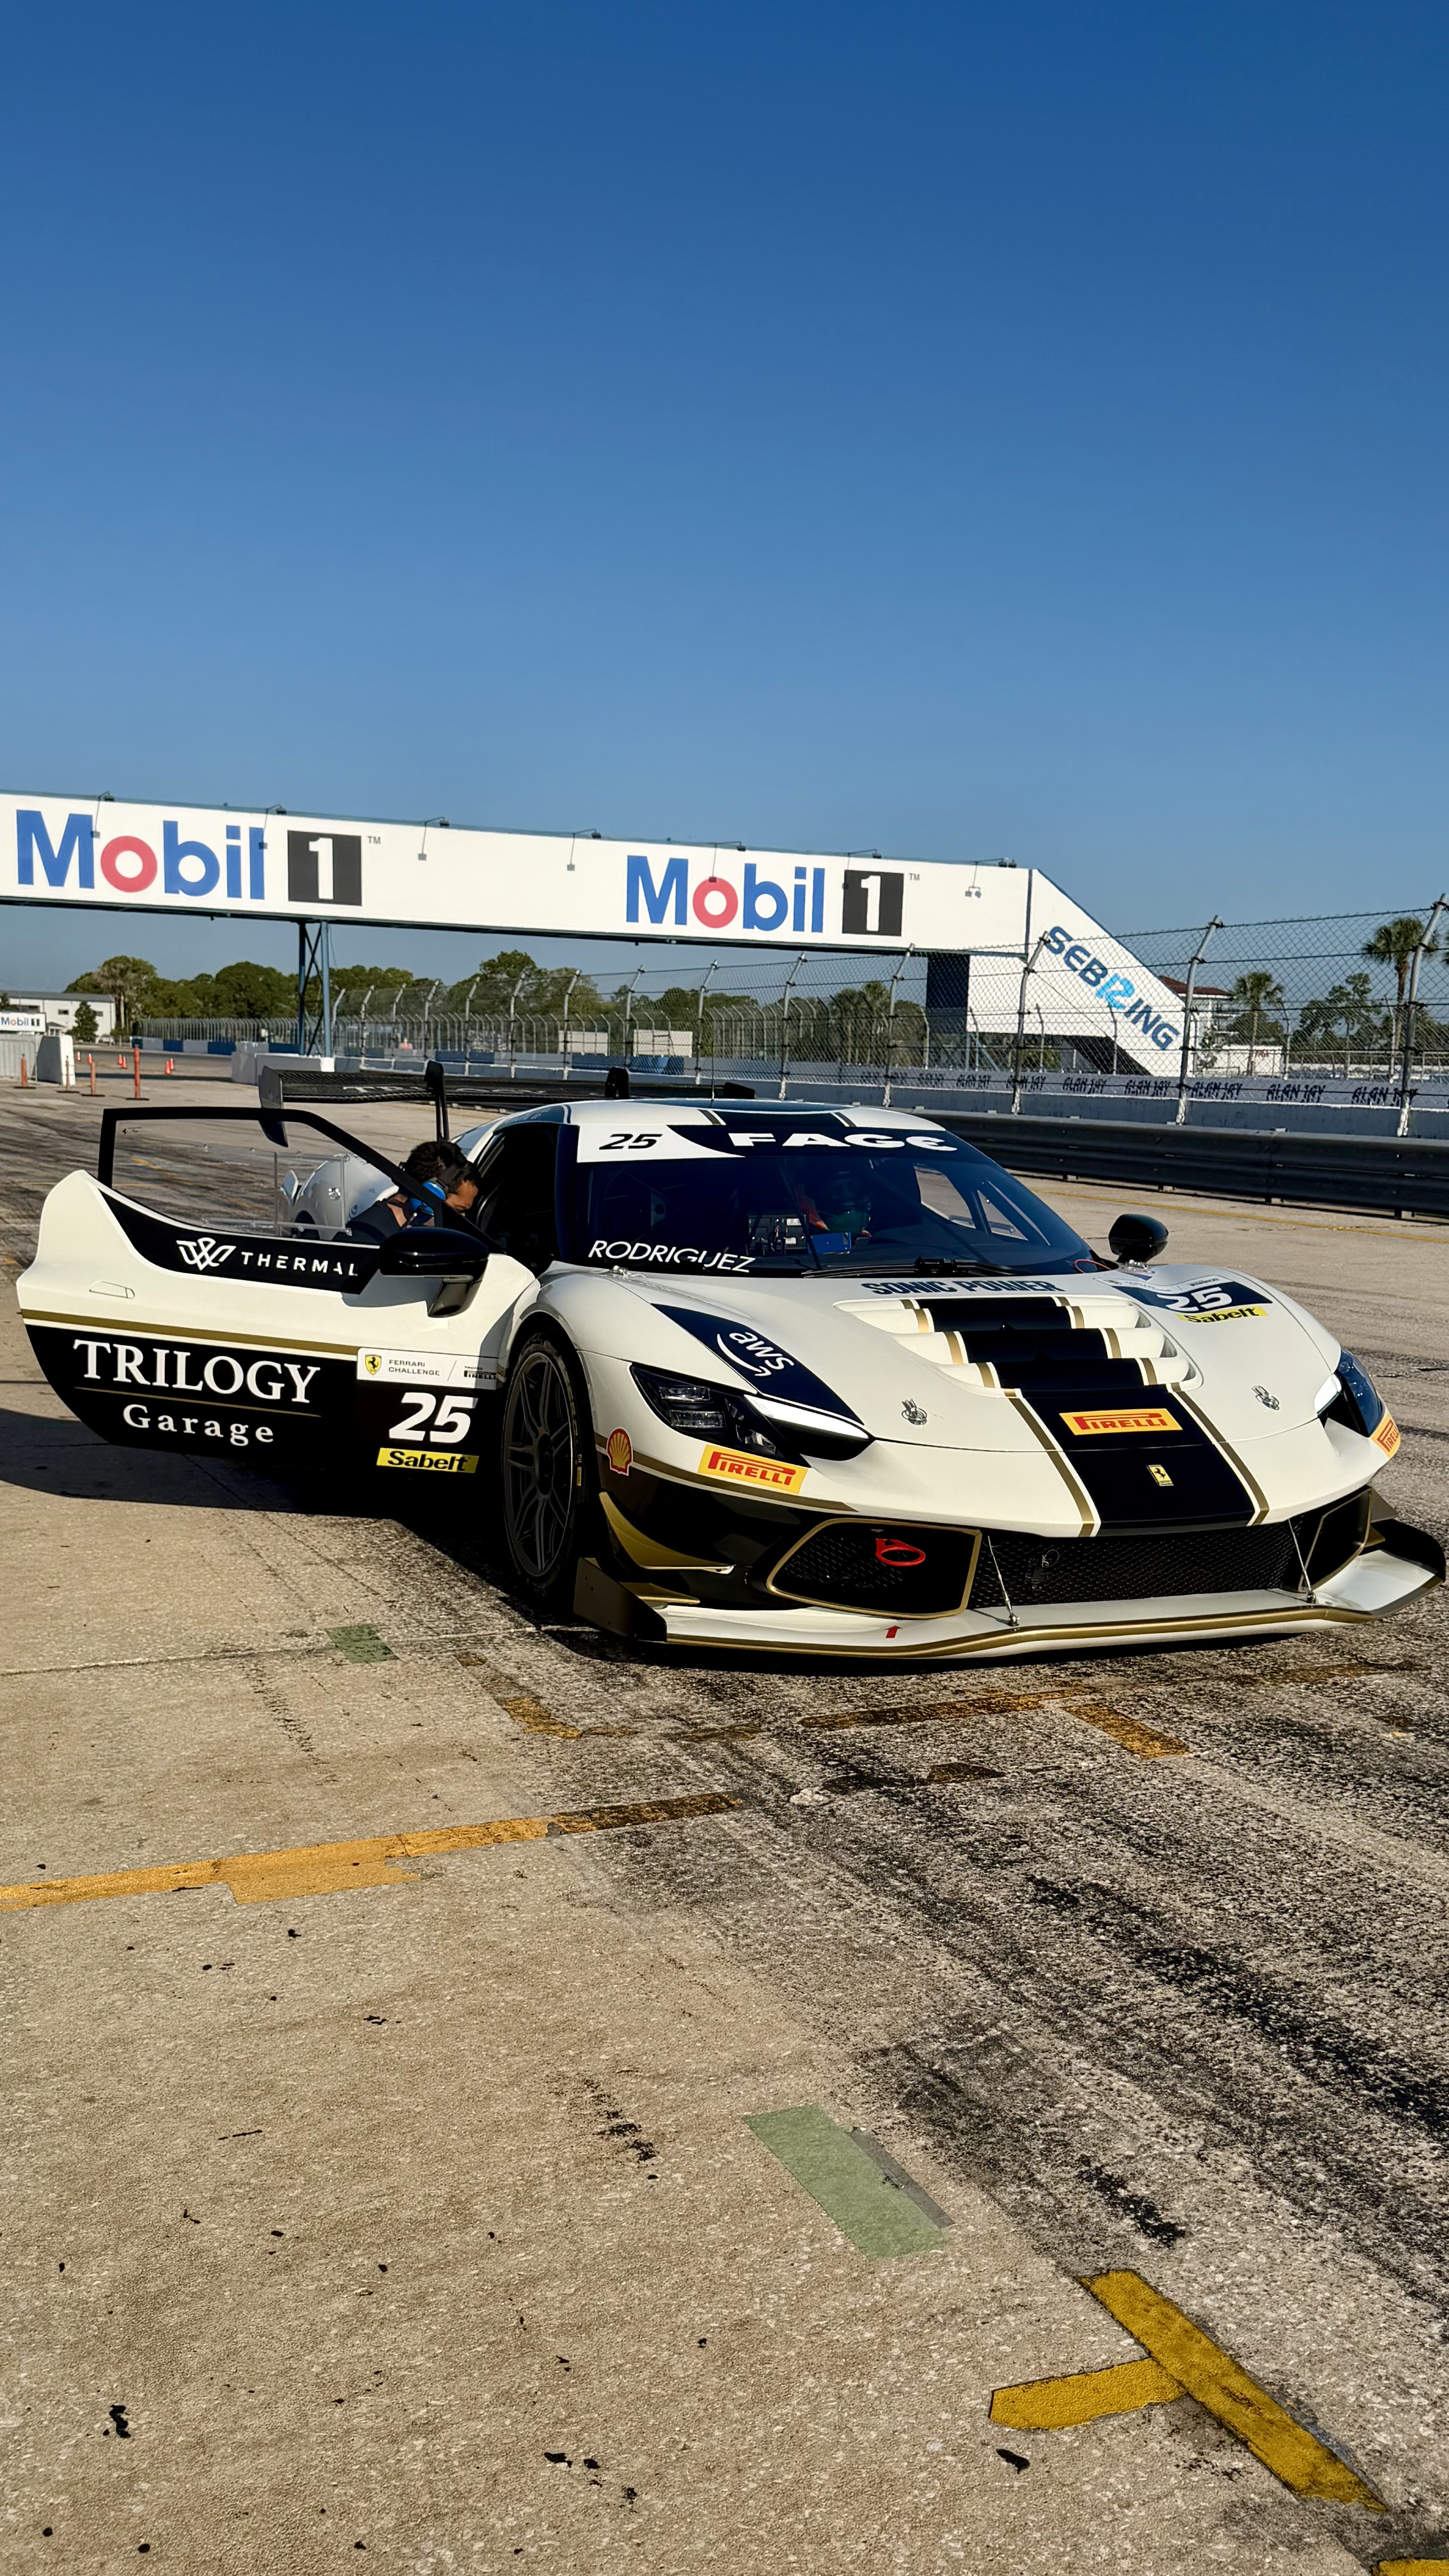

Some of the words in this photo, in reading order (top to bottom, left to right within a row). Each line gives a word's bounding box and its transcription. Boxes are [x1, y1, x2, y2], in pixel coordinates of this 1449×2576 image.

[16, 810, 265, 900] Mobil
[309, 837, 333, 900] 1
[367, 836, 380, 845] TM
[626, 855, 825, 933] Mobil
[861, 875, 881, 932] 1
[1, 1017, 29, 1026] Mobil
[599, 1134, 663, 1150] 25
[728, 1133, 958, 1151] FAGE
[241, 1252, 358, 1276] THERMAL
[588, 1241, 756, 1273] RODRIGUEZ
[861, 1281, 958, 1295] SONIC
[953, 1280, 1066, 1292] POWER
[1157, 1287, 1232, 1312] 25
[1184, 1307, 1259, 1323] Sabelt
[388, 1359, 425, 1367] FERRARI
[729, 1332, 795, 1370] aws
[73, 1339, 321, 1403] TRILOGY
[388, 1367, 440, 1376] CHALLENGE
[123, 1404, 273, 1446] Garage
[389, 1392, 479, 1443] 25
[1073, 1413, 1168, 1430] PIRELLI
[388, 1450, 468, 1471] Sabelt
[708, 1451, 796, 1486] PIRELLI
